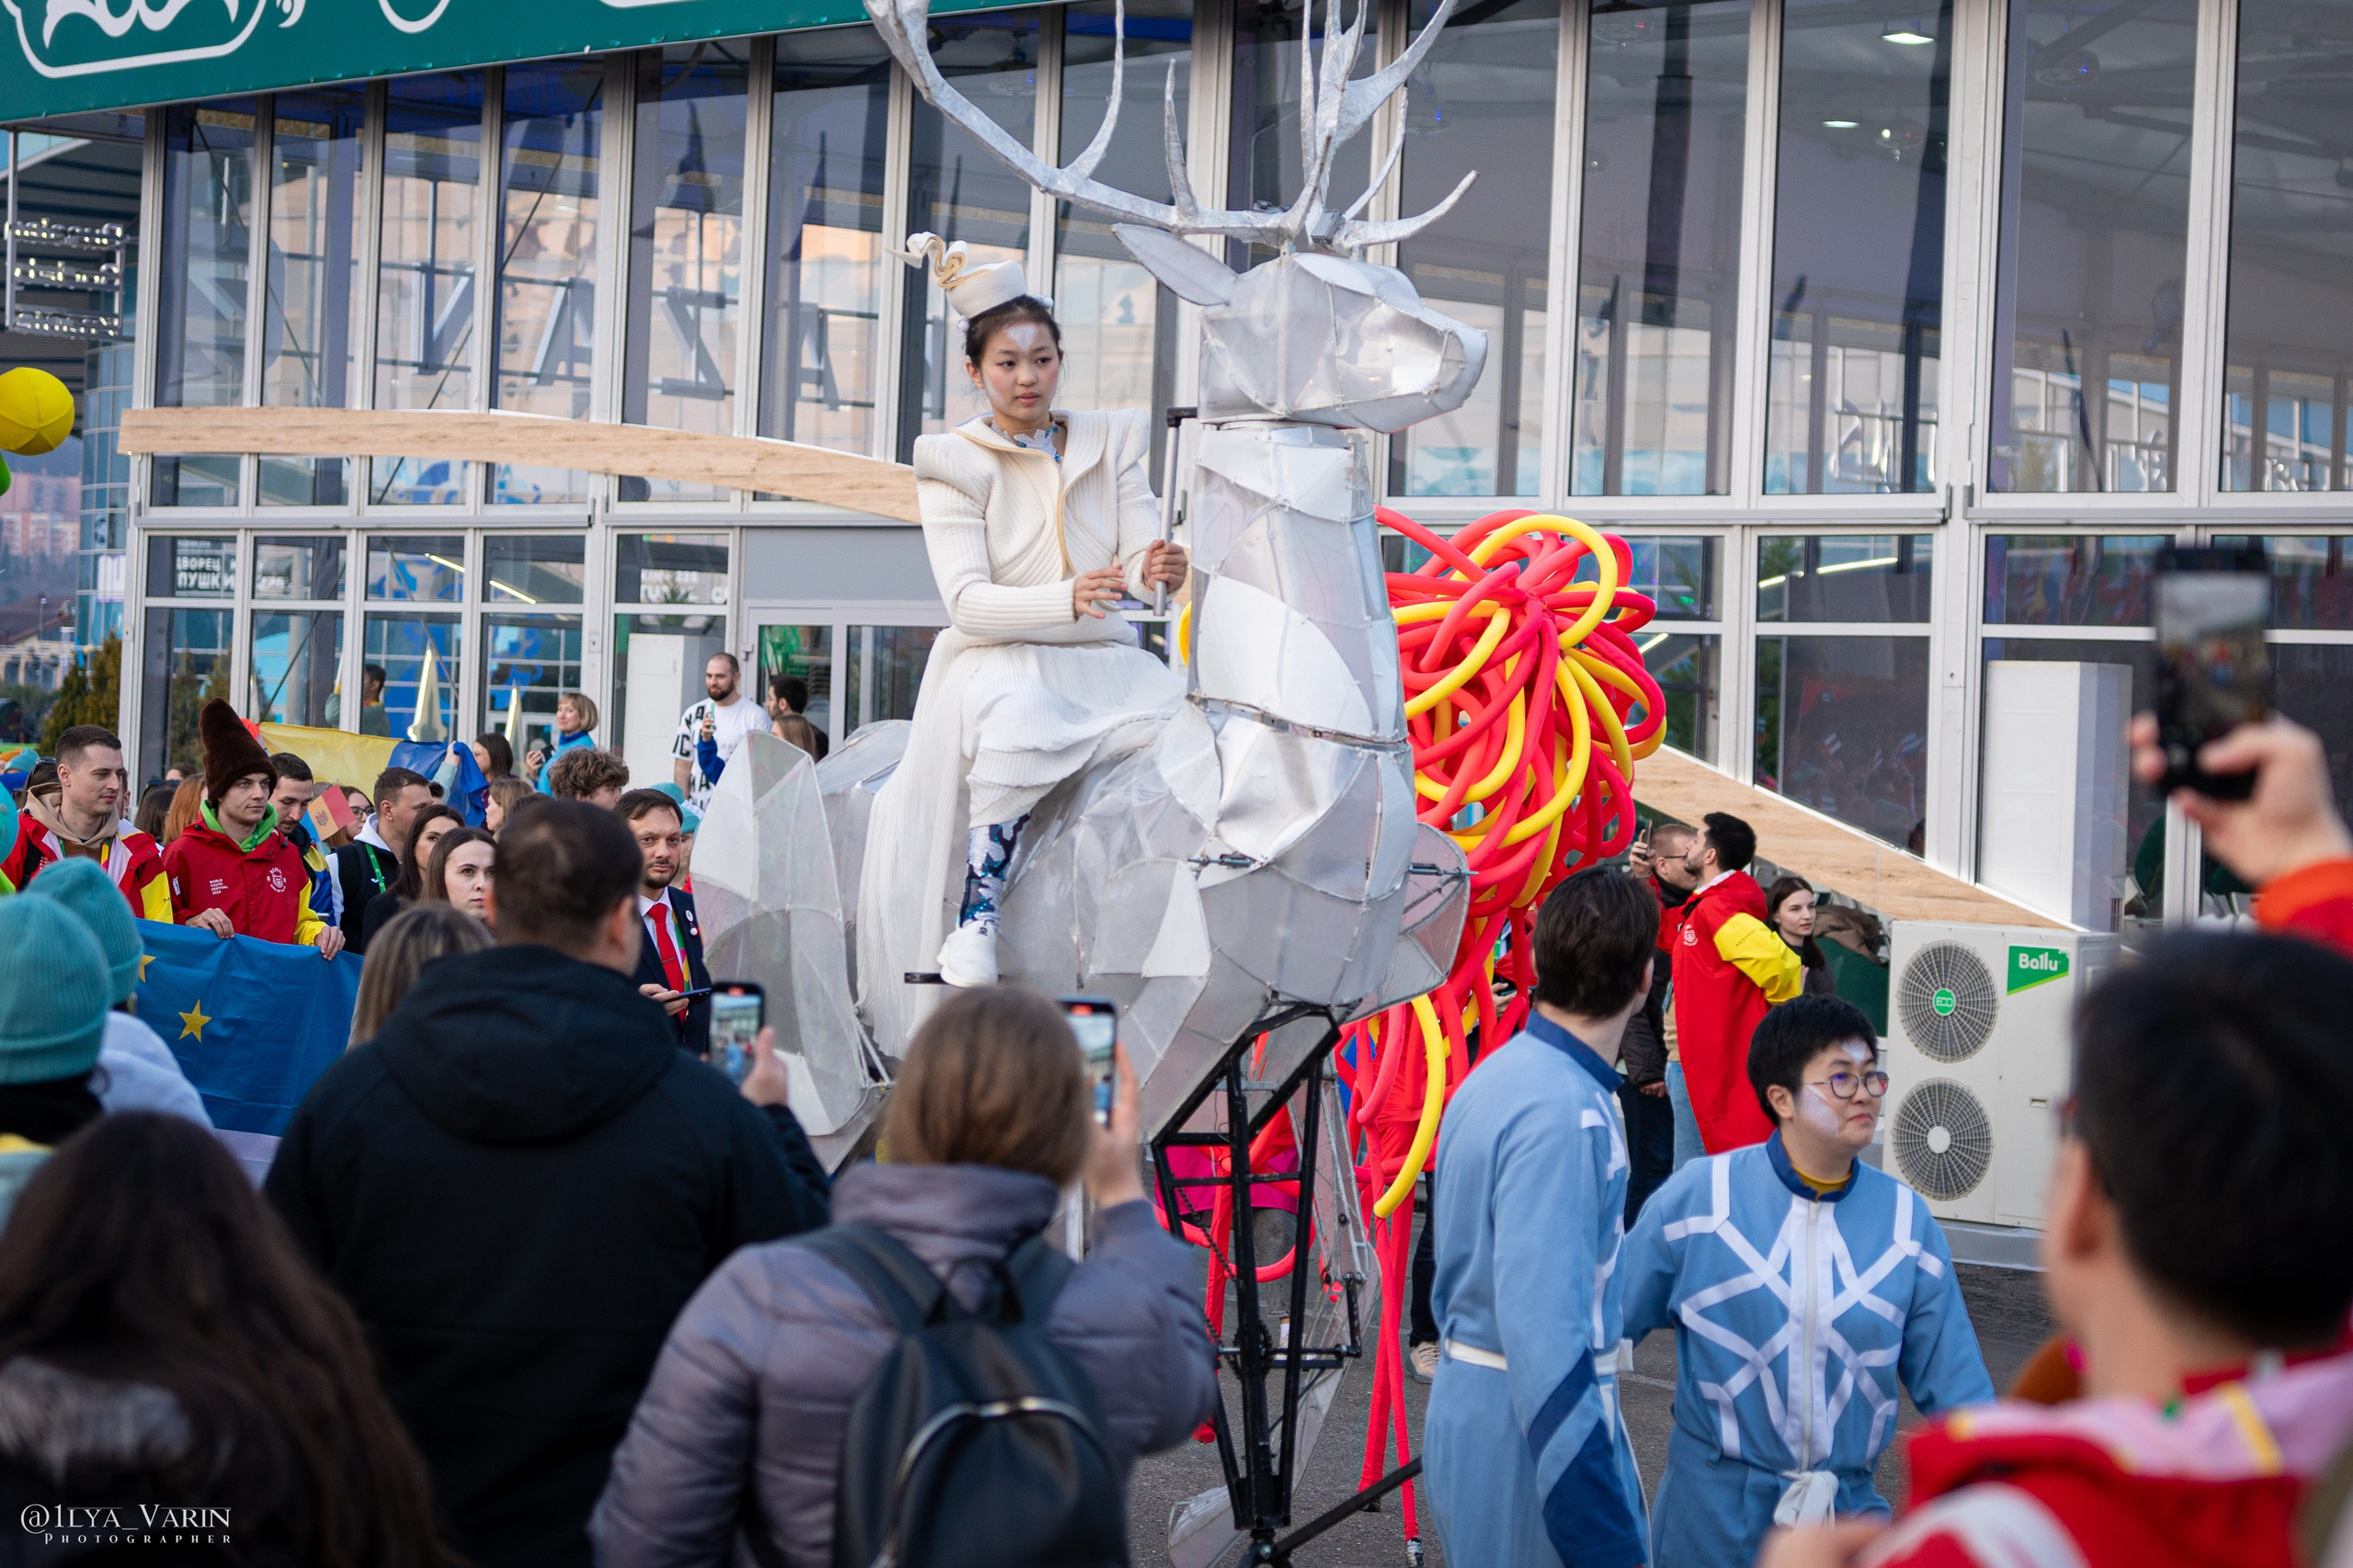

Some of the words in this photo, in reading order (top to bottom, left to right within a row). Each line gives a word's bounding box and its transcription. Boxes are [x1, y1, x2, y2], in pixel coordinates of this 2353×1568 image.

[177, 572, 235, 590] ПУШКИ
[2018, 951, 2058, 971] Ballu
[1936, 996, 1953, 1007] ECO
